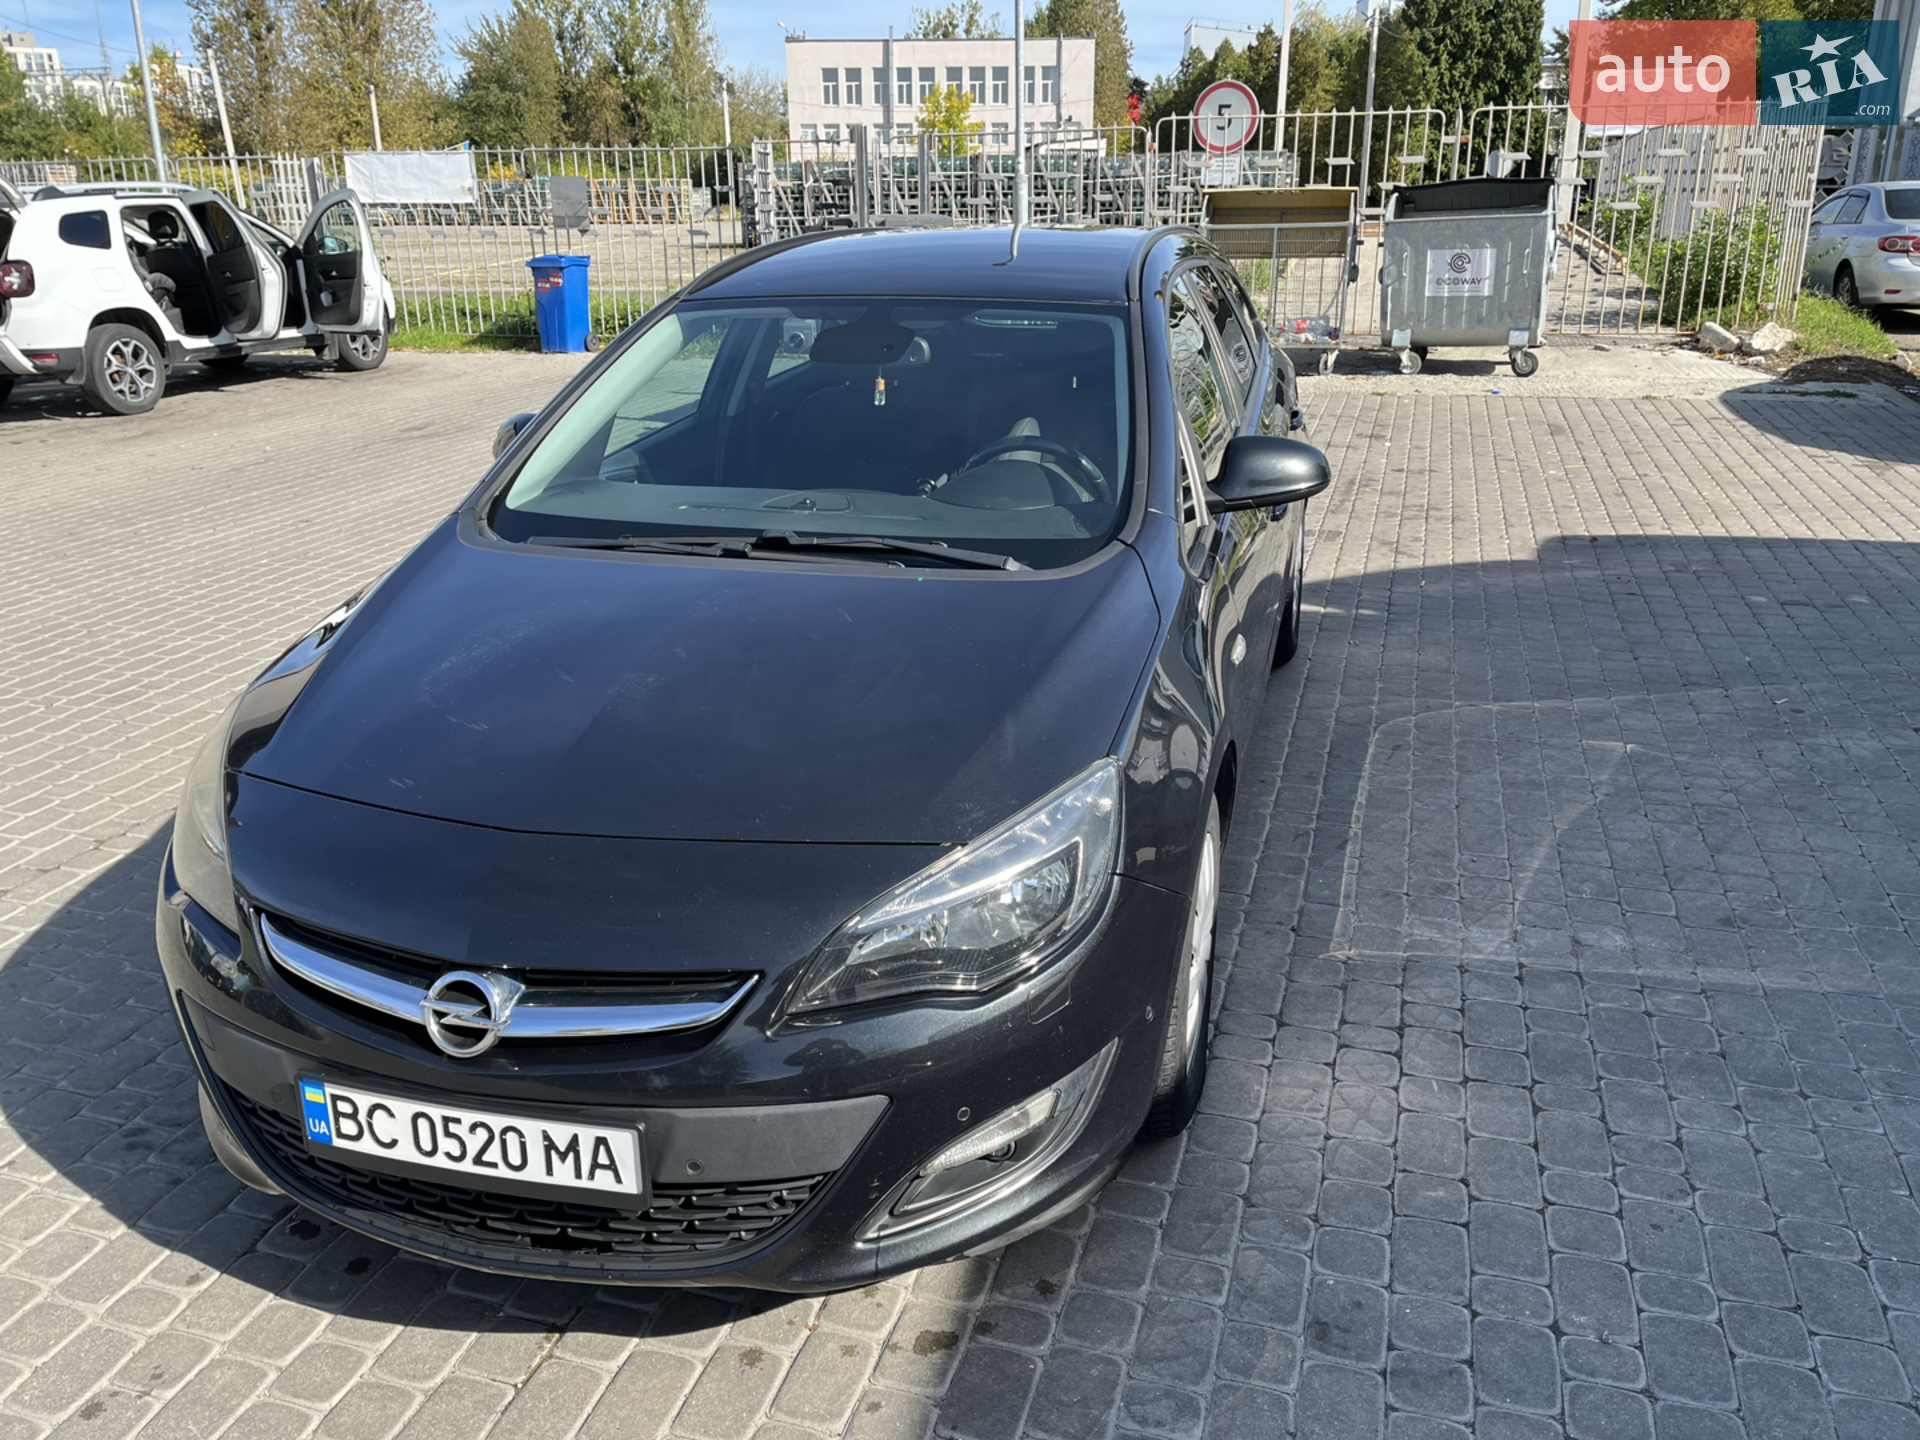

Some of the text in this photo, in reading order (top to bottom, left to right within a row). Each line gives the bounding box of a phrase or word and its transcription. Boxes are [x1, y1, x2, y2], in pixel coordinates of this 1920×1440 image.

[1216, 103, 1233, 131] 5
[308, 1117, 331, 1137] UA
[328, 1092, 624, 1185] BC 0520 MA
